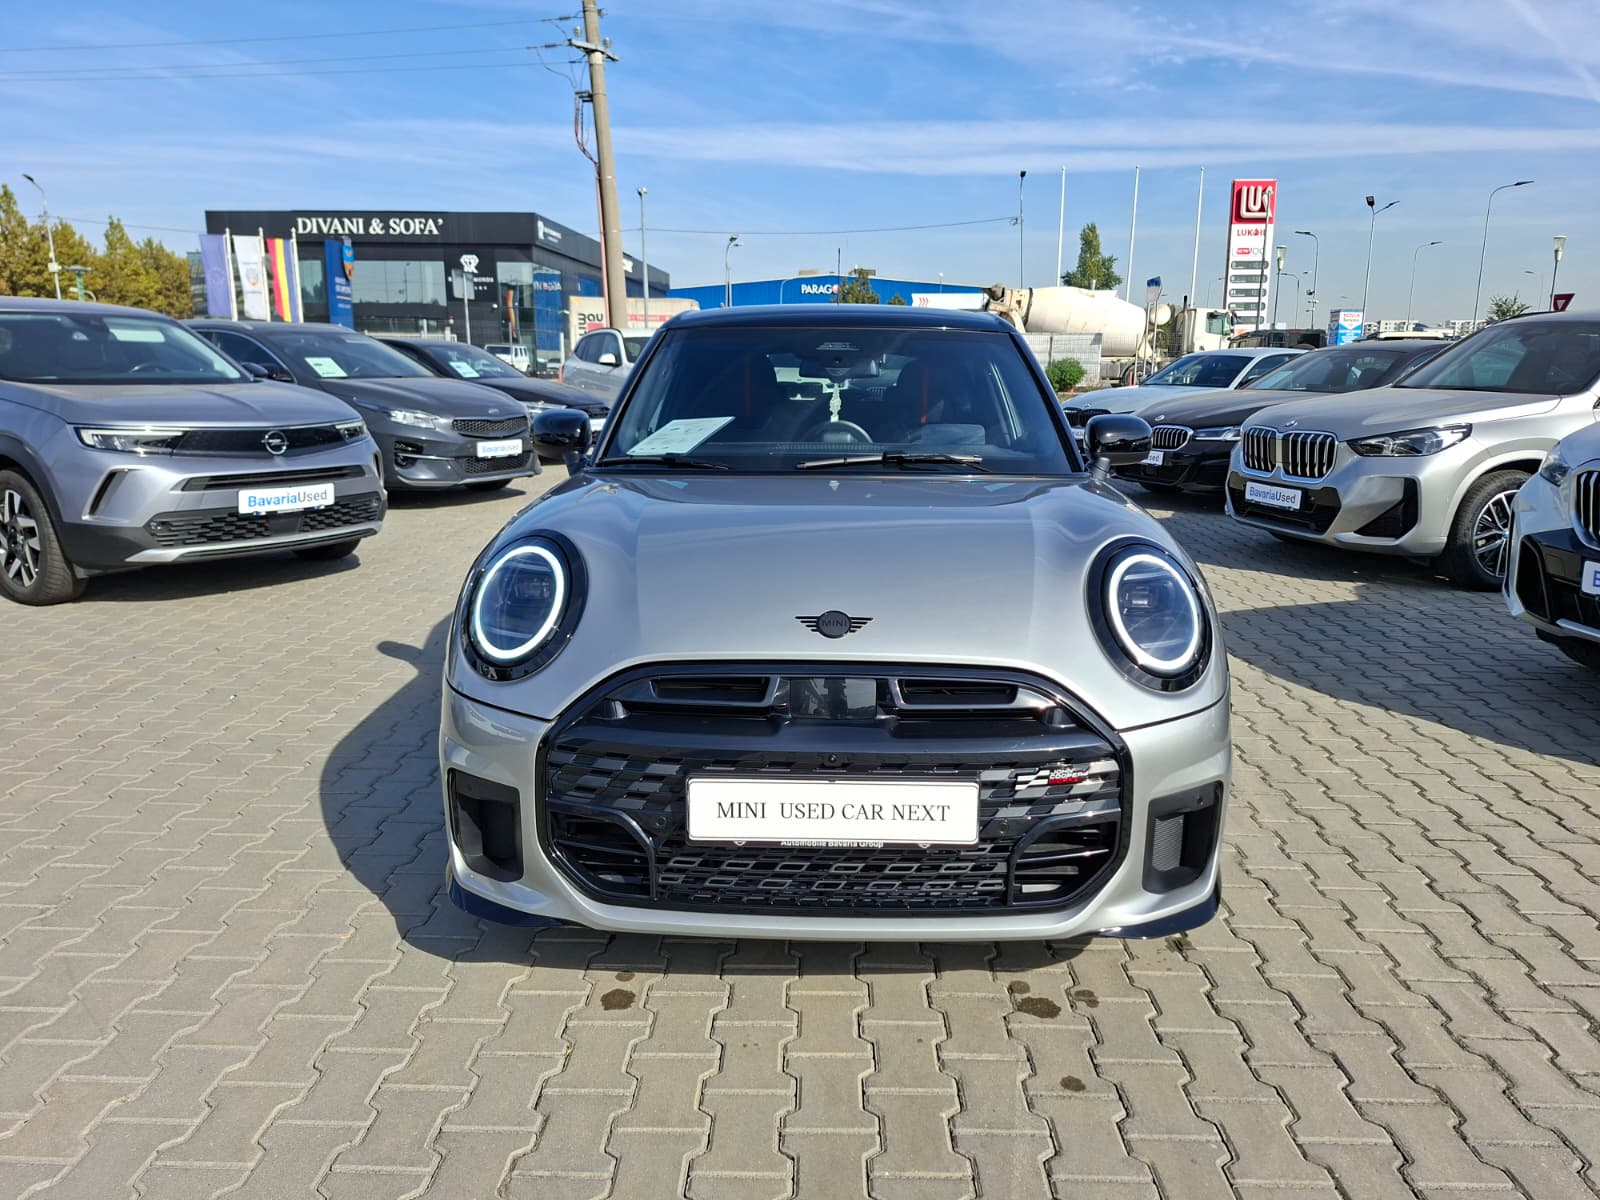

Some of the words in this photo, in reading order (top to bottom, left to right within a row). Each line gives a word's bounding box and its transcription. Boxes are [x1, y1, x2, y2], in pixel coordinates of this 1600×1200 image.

[297, 217, 365, 234] DIVANI
[368, 218, 386, 234] &
[248, 489, 328, 507] BavariaUsed
[1249, 486, 1297, 504] BavariaUsed
[821, 620, 848, 628] MINI
[716, 801, 767, 819] MINI
[780, 802, 836, 819] USED
[841, 803, 884, 820] CAR
[891, 804, 951, 821] NEXT
[780, 839, 827, 848] Automobile
[828, 840, 858, 848] Bavaria
[859, 840, 885, 849] Group
